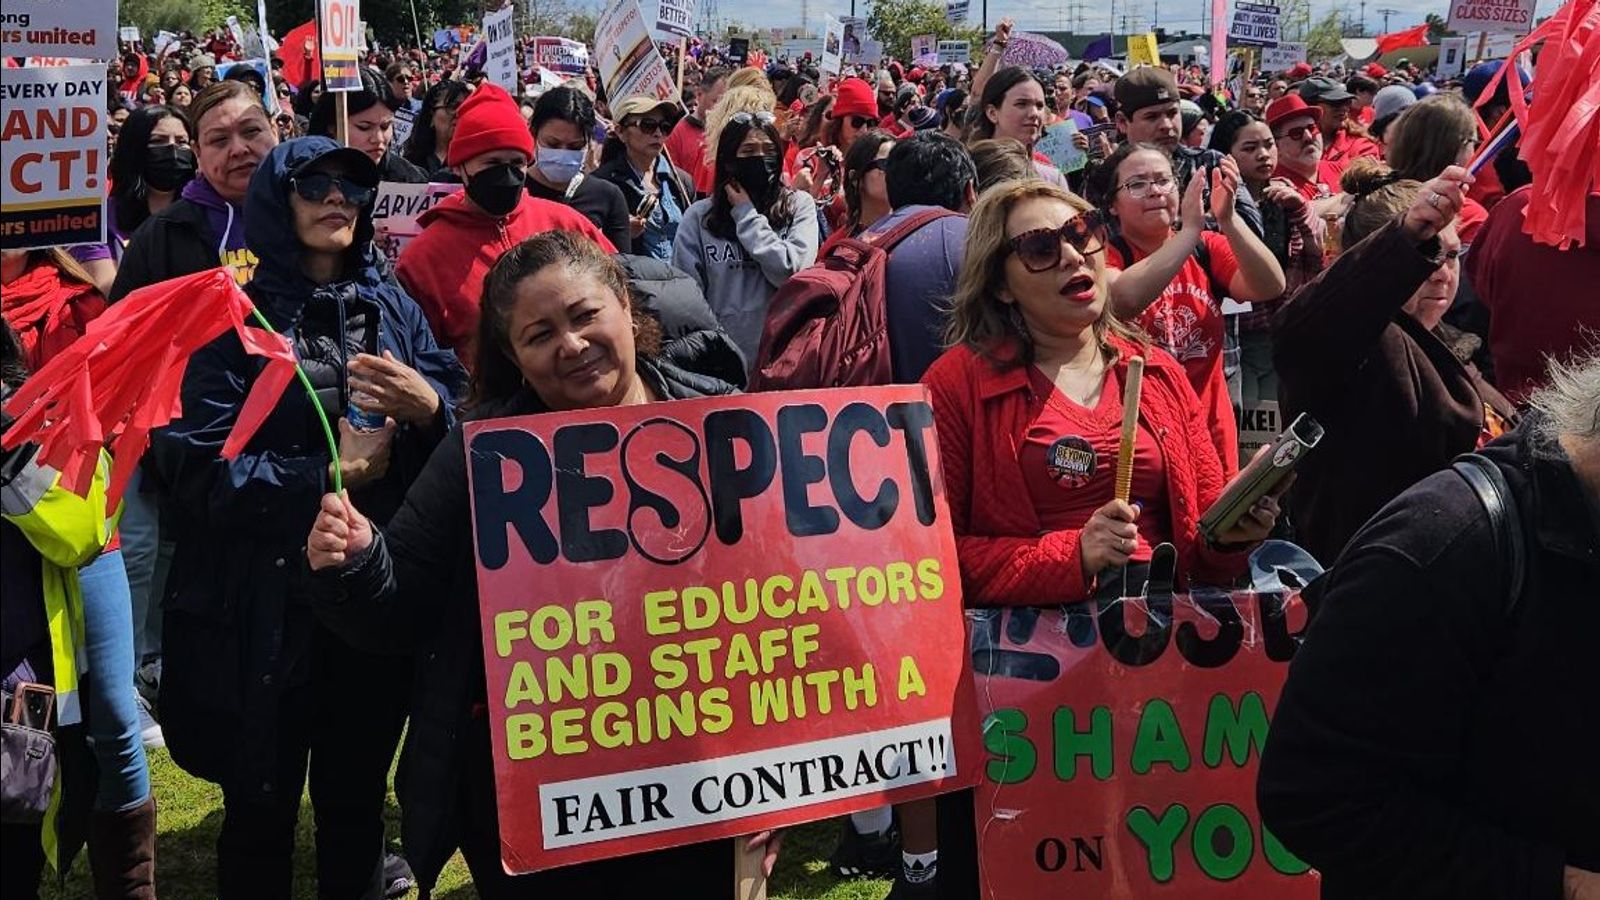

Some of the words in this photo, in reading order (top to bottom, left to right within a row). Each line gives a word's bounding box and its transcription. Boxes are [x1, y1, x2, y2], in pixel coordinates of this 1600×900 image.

[660, 6, 686, 24] BETTER
[1456, 5, 1491, 20] CLASS
[1491, 8, 1528, 24] SIZES
[26, 27, 96, 45] united
[1253, 26, 1277, 39] LIVES!
[1, 82, 59, 100] EVERY
[64, 80, 103, 97] DAY
[1, 106, 98, 142] AND
[10, 148, 98, 194] CT!
[30, 211, 98, 234] united
[1240, 409, 1276, 432] KE!
[1056, 445, 1093, 466] BEYOND
[469, 401, 937, 570] RESPECT
[494, 599, 616, 657] FOR
[644, 557, 945, 637] EDUCATORS
[504, 652, 633, 710] AND
[649, 623, 822, 690] STAFF
[505, 686, 734, 761] BEGINS
[749, 662, 878, 727] WITH
[898, 655, 928, 702] A
[551, 781, 675, 838] FAIR
[691, 734, 949, 816] CONTRACT!!
[1035, 836, 1104, 873] ON
